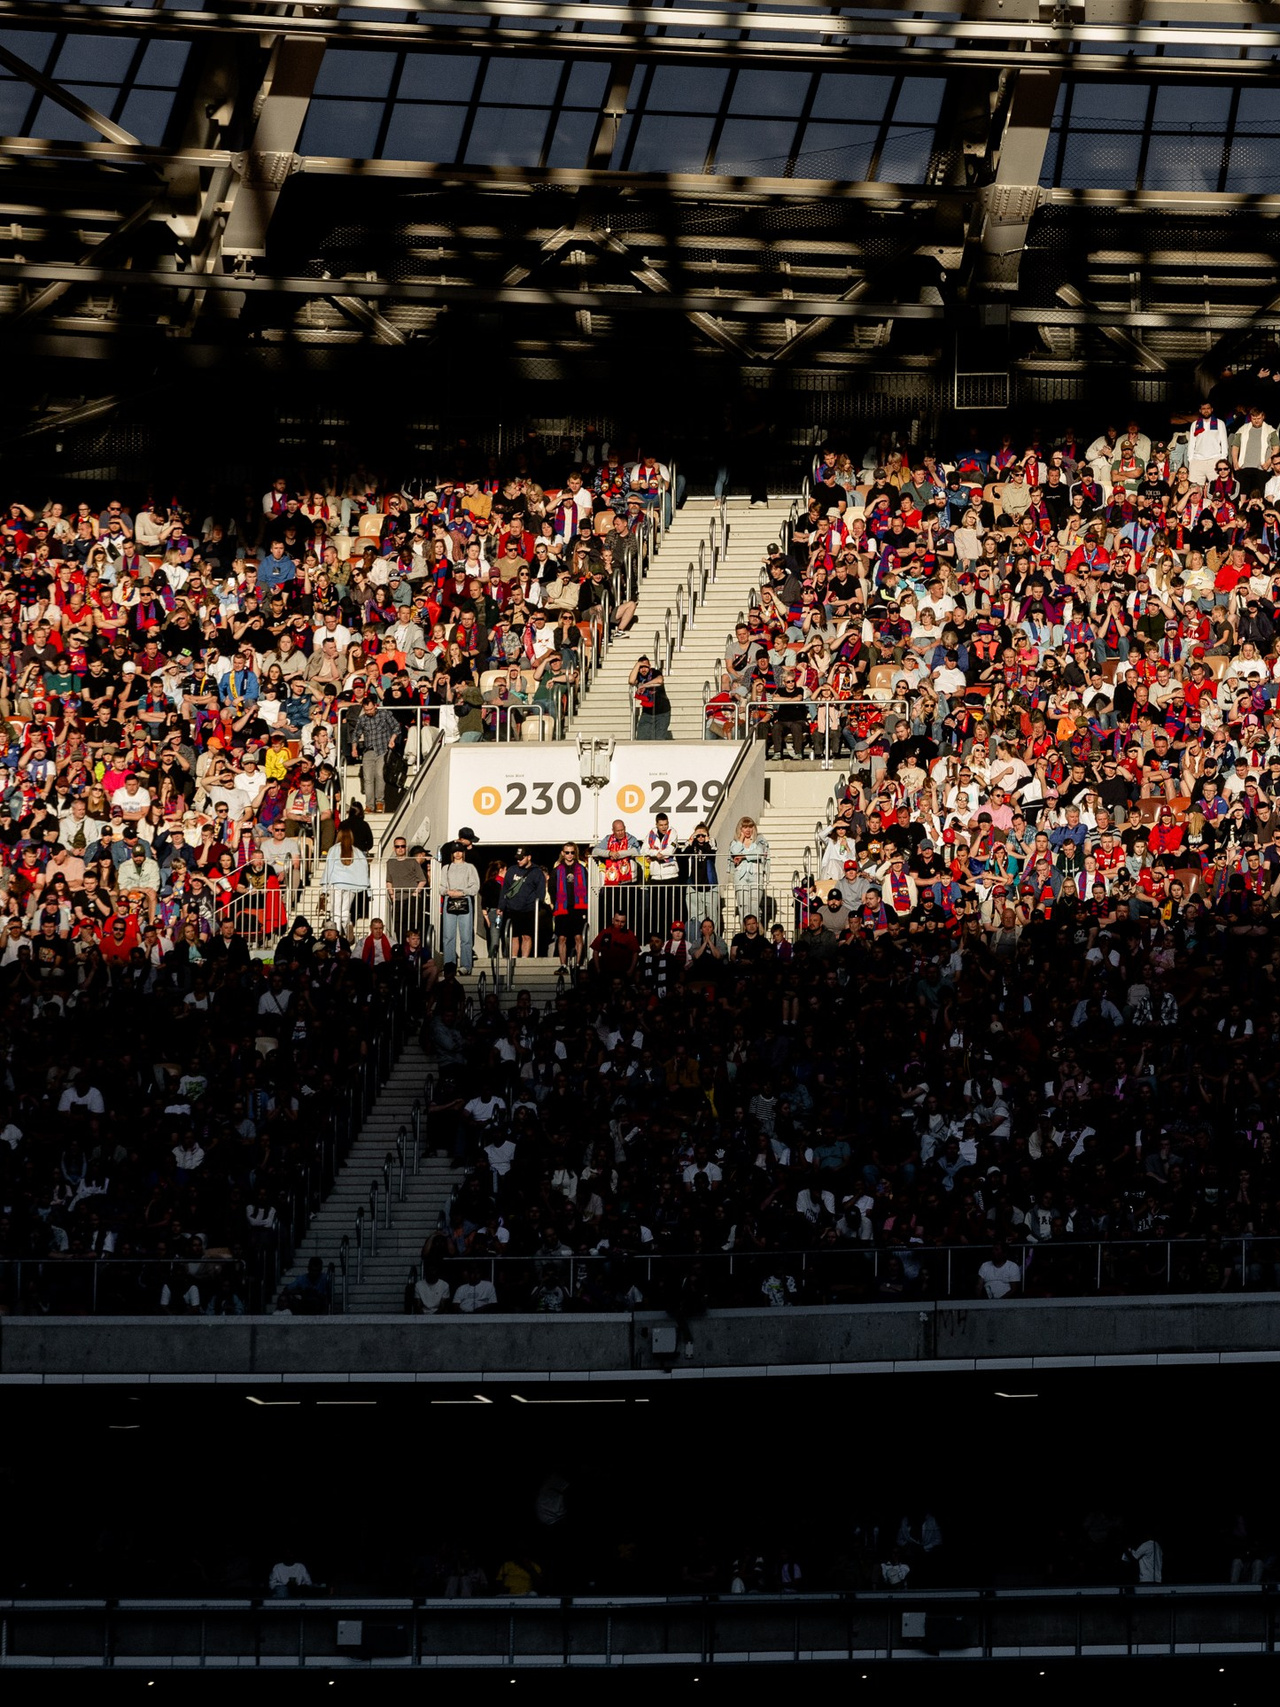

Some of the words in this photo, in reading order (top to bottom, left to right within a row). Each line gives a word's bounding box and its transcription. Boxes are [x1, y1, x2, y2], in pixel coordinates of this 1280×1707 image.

[481, 792, 496, 810] D
[504, 781, 582, 816] 230
[624, 790, 639, 808] D
[649, 779, 723, 814] 229
